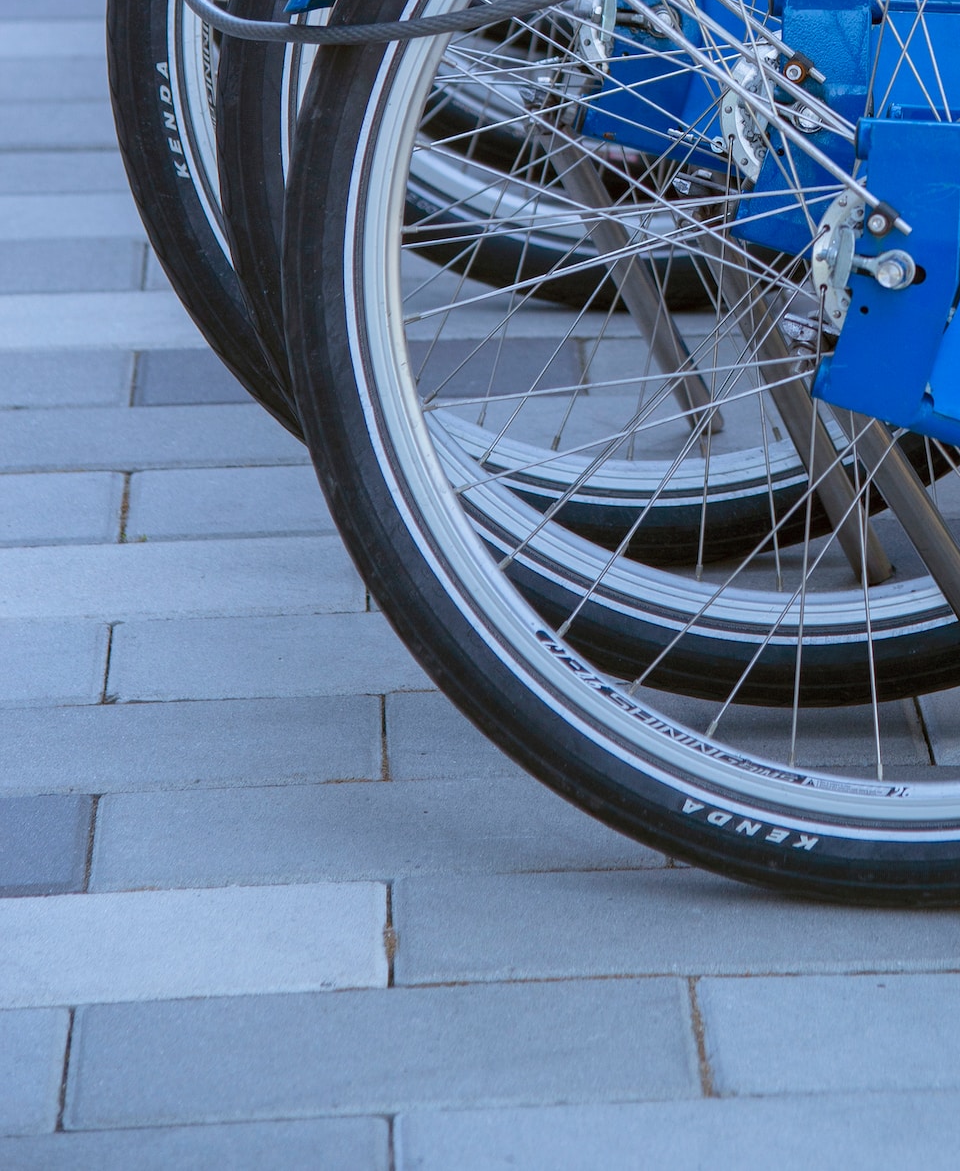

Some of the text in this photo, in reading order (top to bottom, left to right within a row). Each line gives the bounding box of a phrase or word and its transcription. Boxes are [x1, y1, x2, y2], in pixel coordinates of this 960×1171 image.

[155, 61, 191, 179] KENDA
[610, 692, 741, 765] SHINING
[681, 797, 819, 852] KENDA
